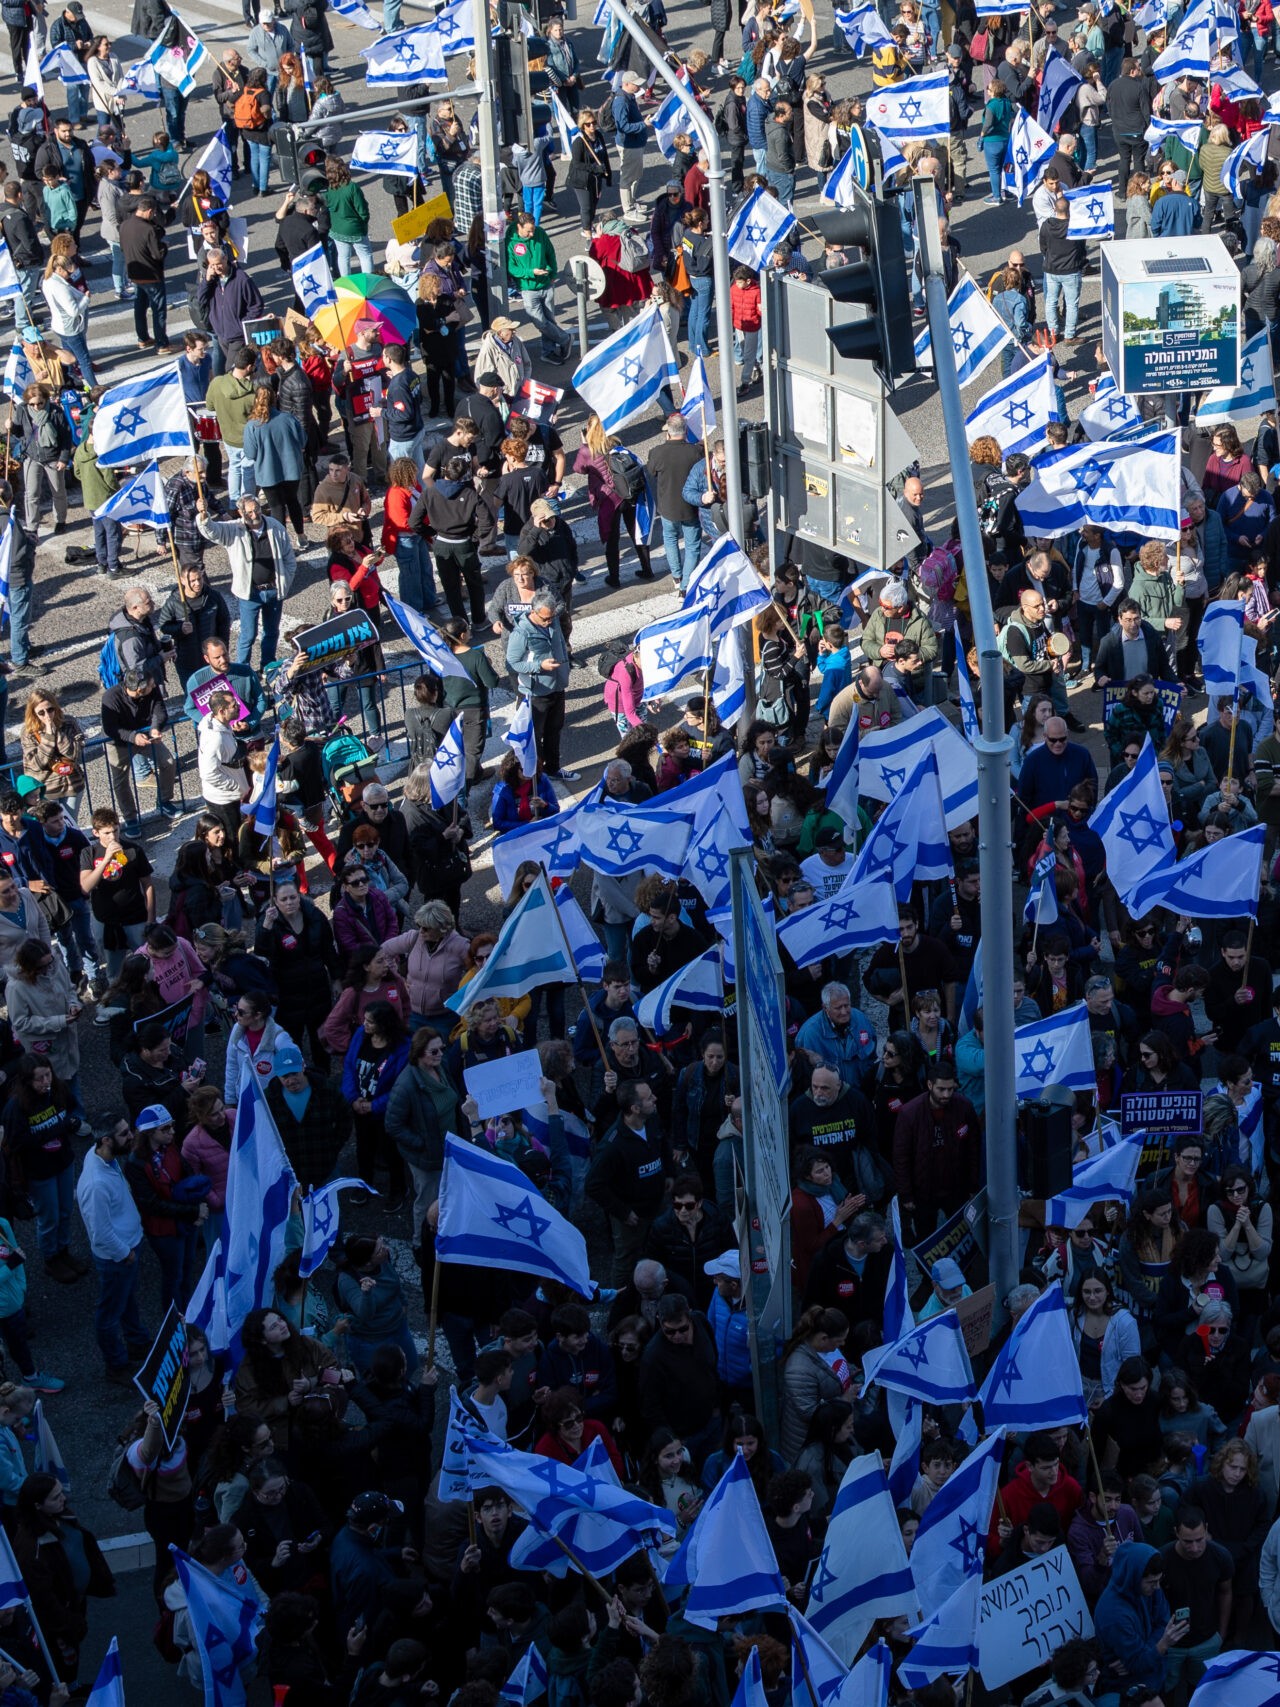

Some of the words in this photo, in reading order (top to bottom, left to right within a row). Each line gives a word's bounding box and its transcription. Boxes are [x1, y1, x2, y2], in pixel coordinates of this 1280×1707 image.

[1166, 334, 1174, 345] 5
[1144, 351, 1175, 365] החלה
[1177, 348, 1218, 362] המכירה
[347, 621, 373, 647] אין
[306, 632, 346, 661] חינוך
[1161, 689, 1179, 707] בלי
[1126, 1096, 1158, 1109] חולה
[1161, 1095, 1197, 1108] הנפש
[1126, 1107, 1197, 1122] מדיקטטורה
[169, 1321, 186, 1364] אין
[152, 1349, 177, 1407] חינוך
[1032, 1552, 1063, 1582] שר
[1017, 1585, 1070, 1640] תומך
